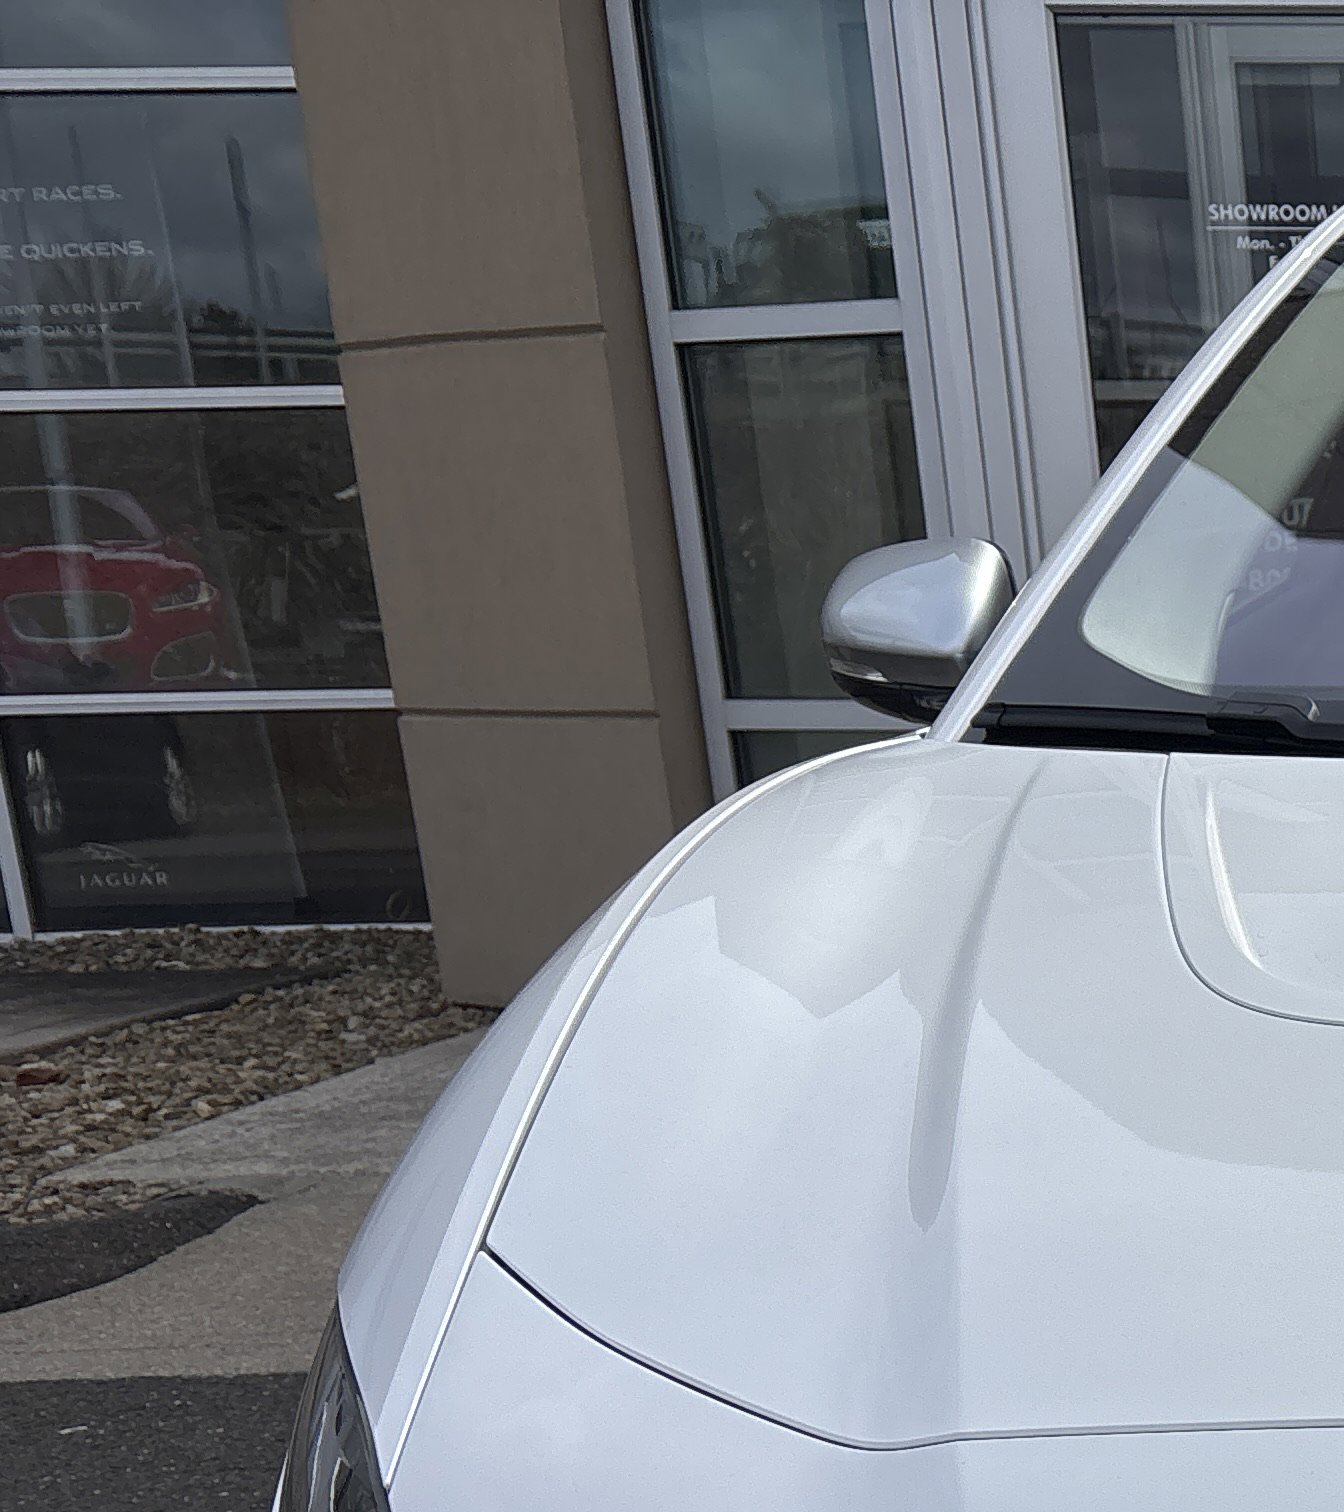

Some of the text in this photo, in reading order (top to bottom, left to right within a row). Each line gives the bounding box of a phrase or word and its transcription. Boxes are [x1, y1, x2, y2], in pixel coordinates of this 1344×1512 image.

[32, 184, 122, 201] RACES.
[1208, 203, 1328, 221] SHOWROOM
[20, 240, 155, 261] QUICKENS.
[1236, 235, 1275, 249] Mon.
[100, 301, 142, 313] LEFT
[79, 870, 169, 889] JAGUAR
